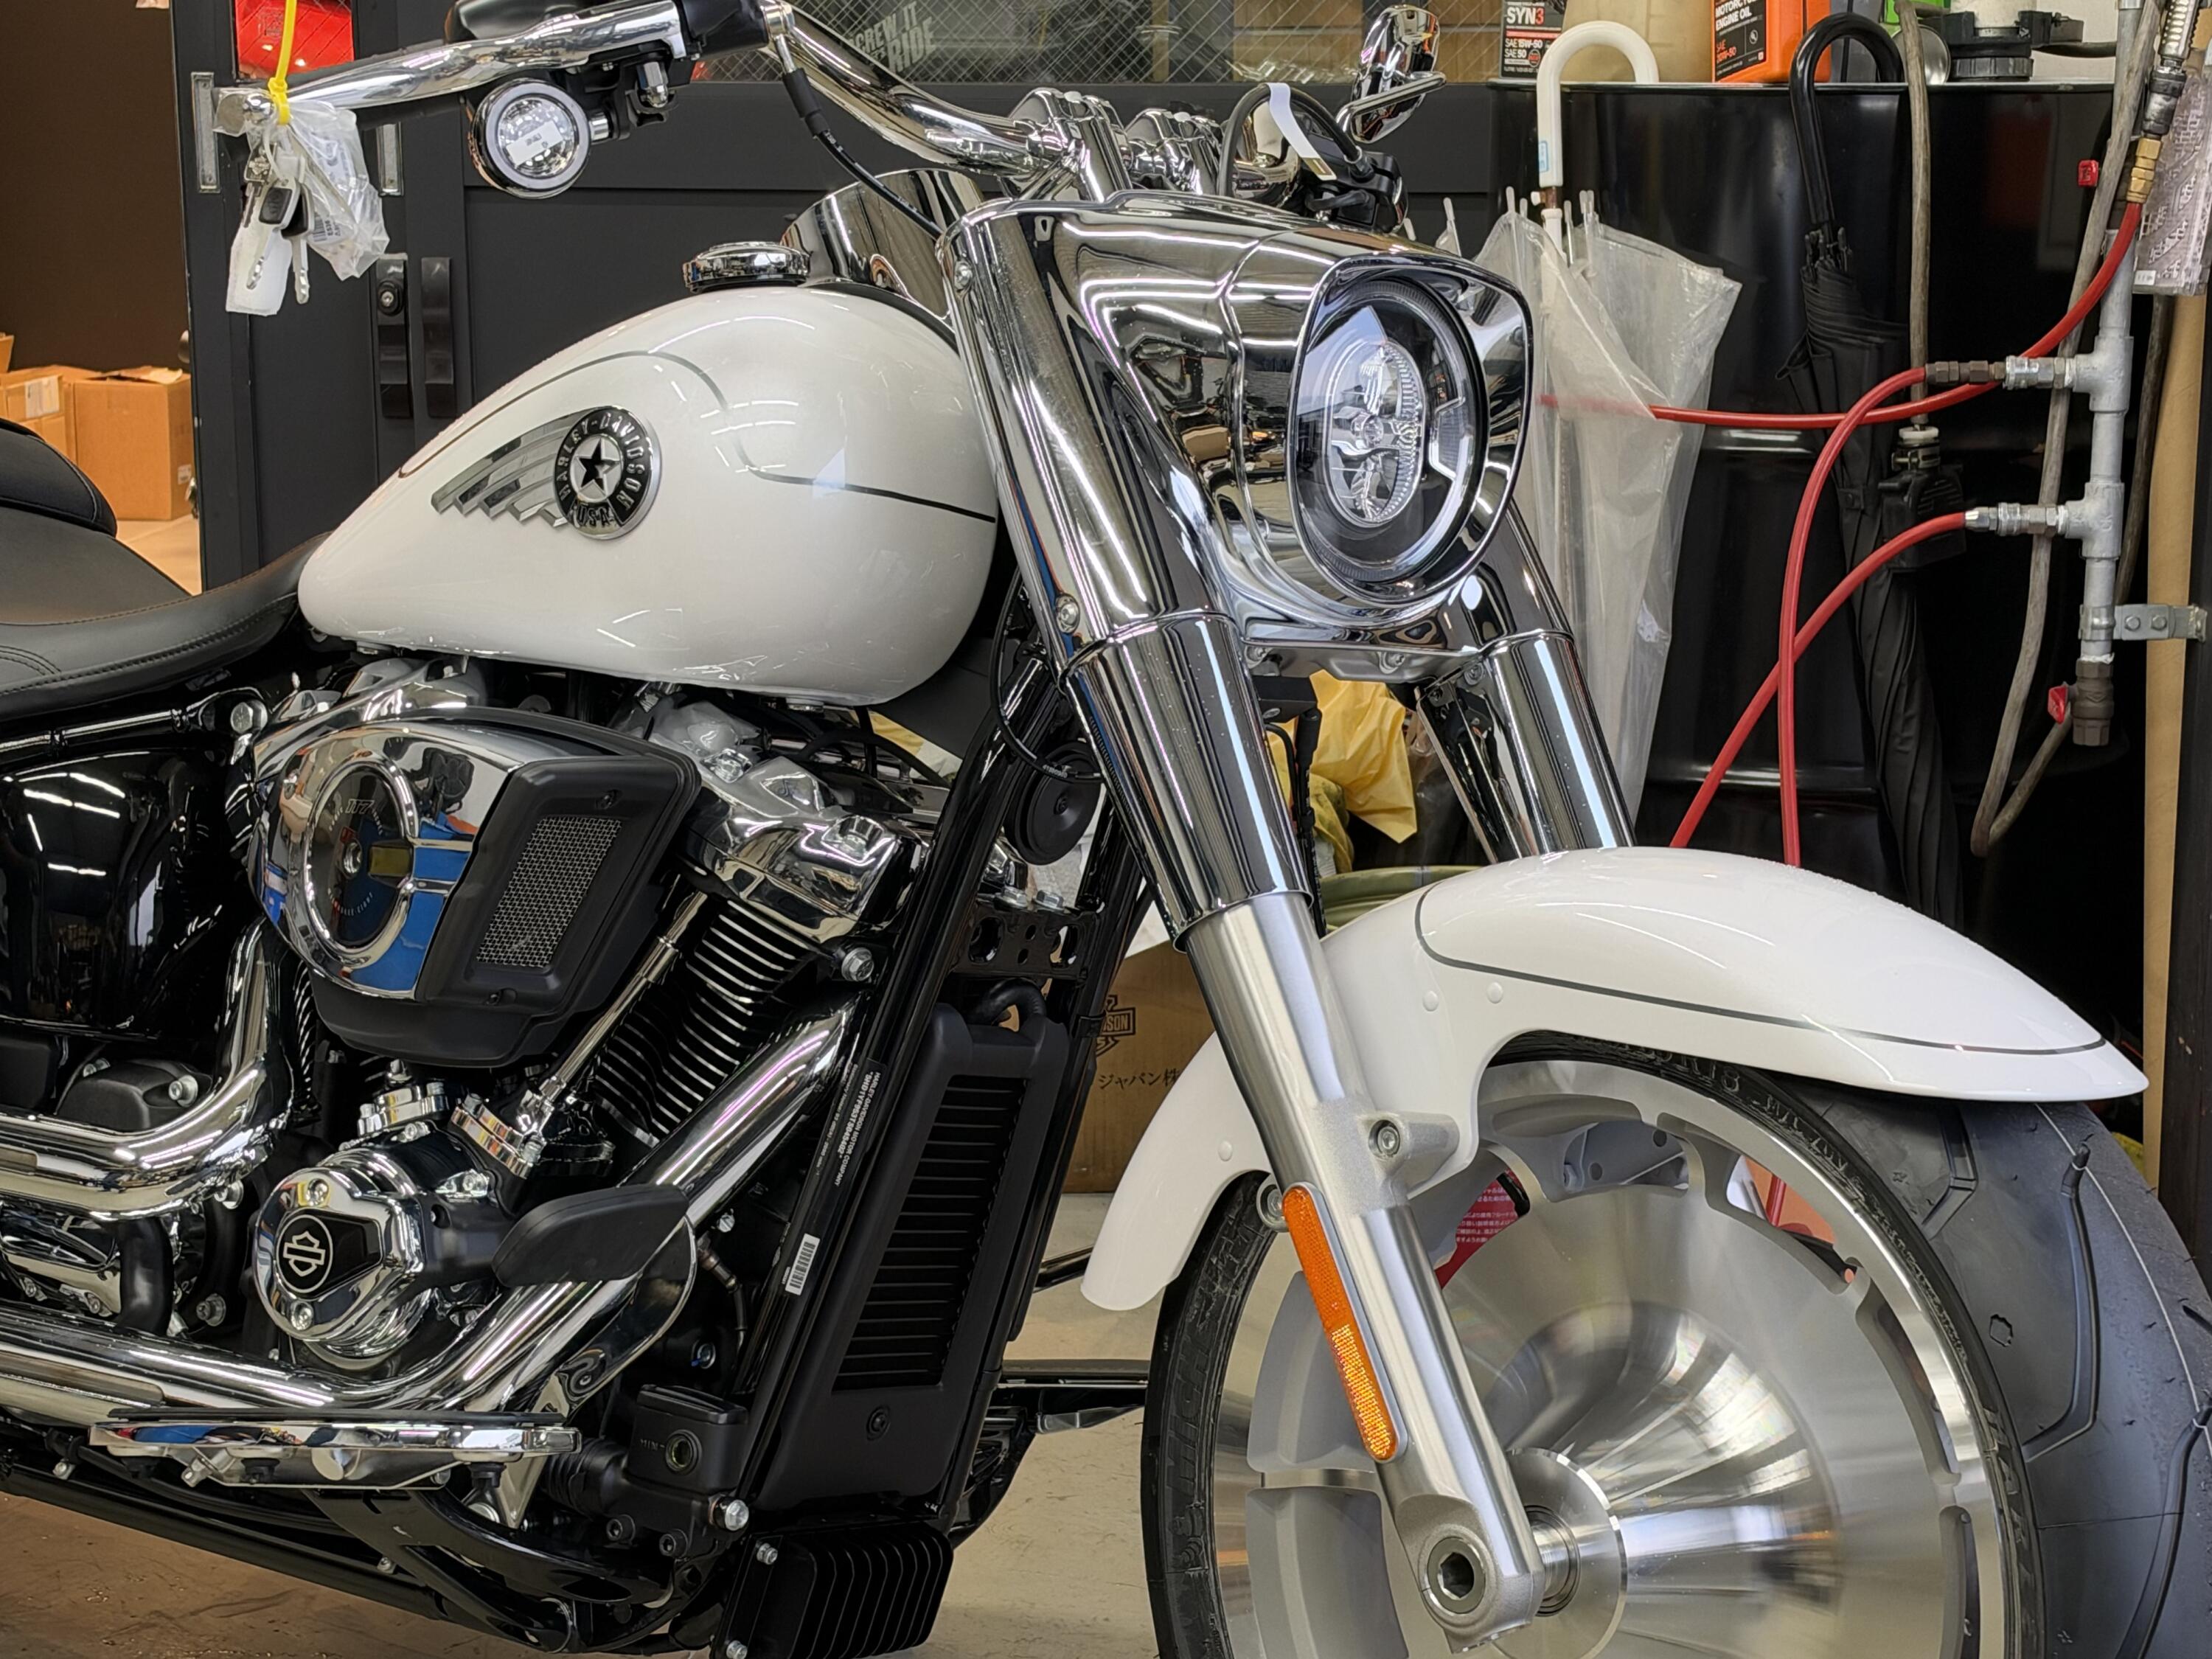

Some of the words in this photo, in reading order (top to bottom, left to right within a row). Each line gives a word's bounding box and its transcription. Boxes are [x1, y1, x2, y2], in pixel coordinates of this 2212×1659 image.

[1506, 7, 1544, 25] SYN3
[1716, 10, 1739, 31] ENGINE
[1739, 6, 1752, 20] OIL
[887, 16, 936, 74] RIDE
